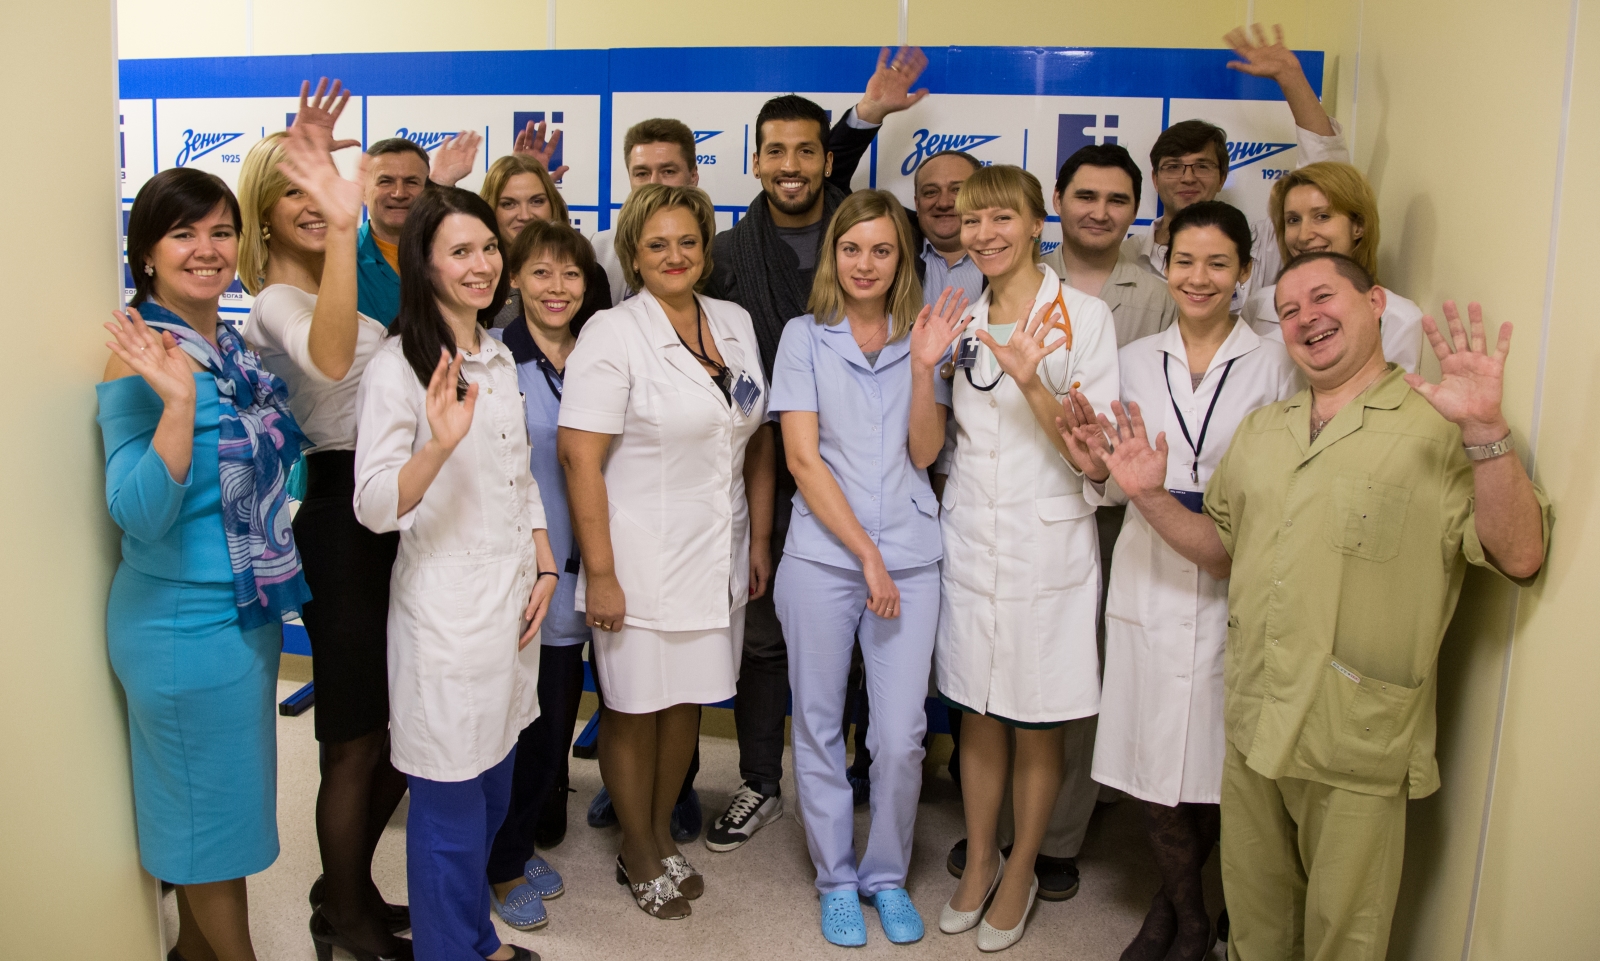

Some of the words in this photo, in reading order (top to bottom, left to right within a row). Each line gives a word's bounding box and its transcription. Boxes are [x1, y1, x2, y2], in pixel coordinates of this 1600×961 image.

[175, 128, 245, 168] Зенит
[221, 154, 241, 163] 1925
[696, 154, 717, 165] 925
[901, 128, 1002, 176] Зенит
[1226, 141, 1298, 172] енит
